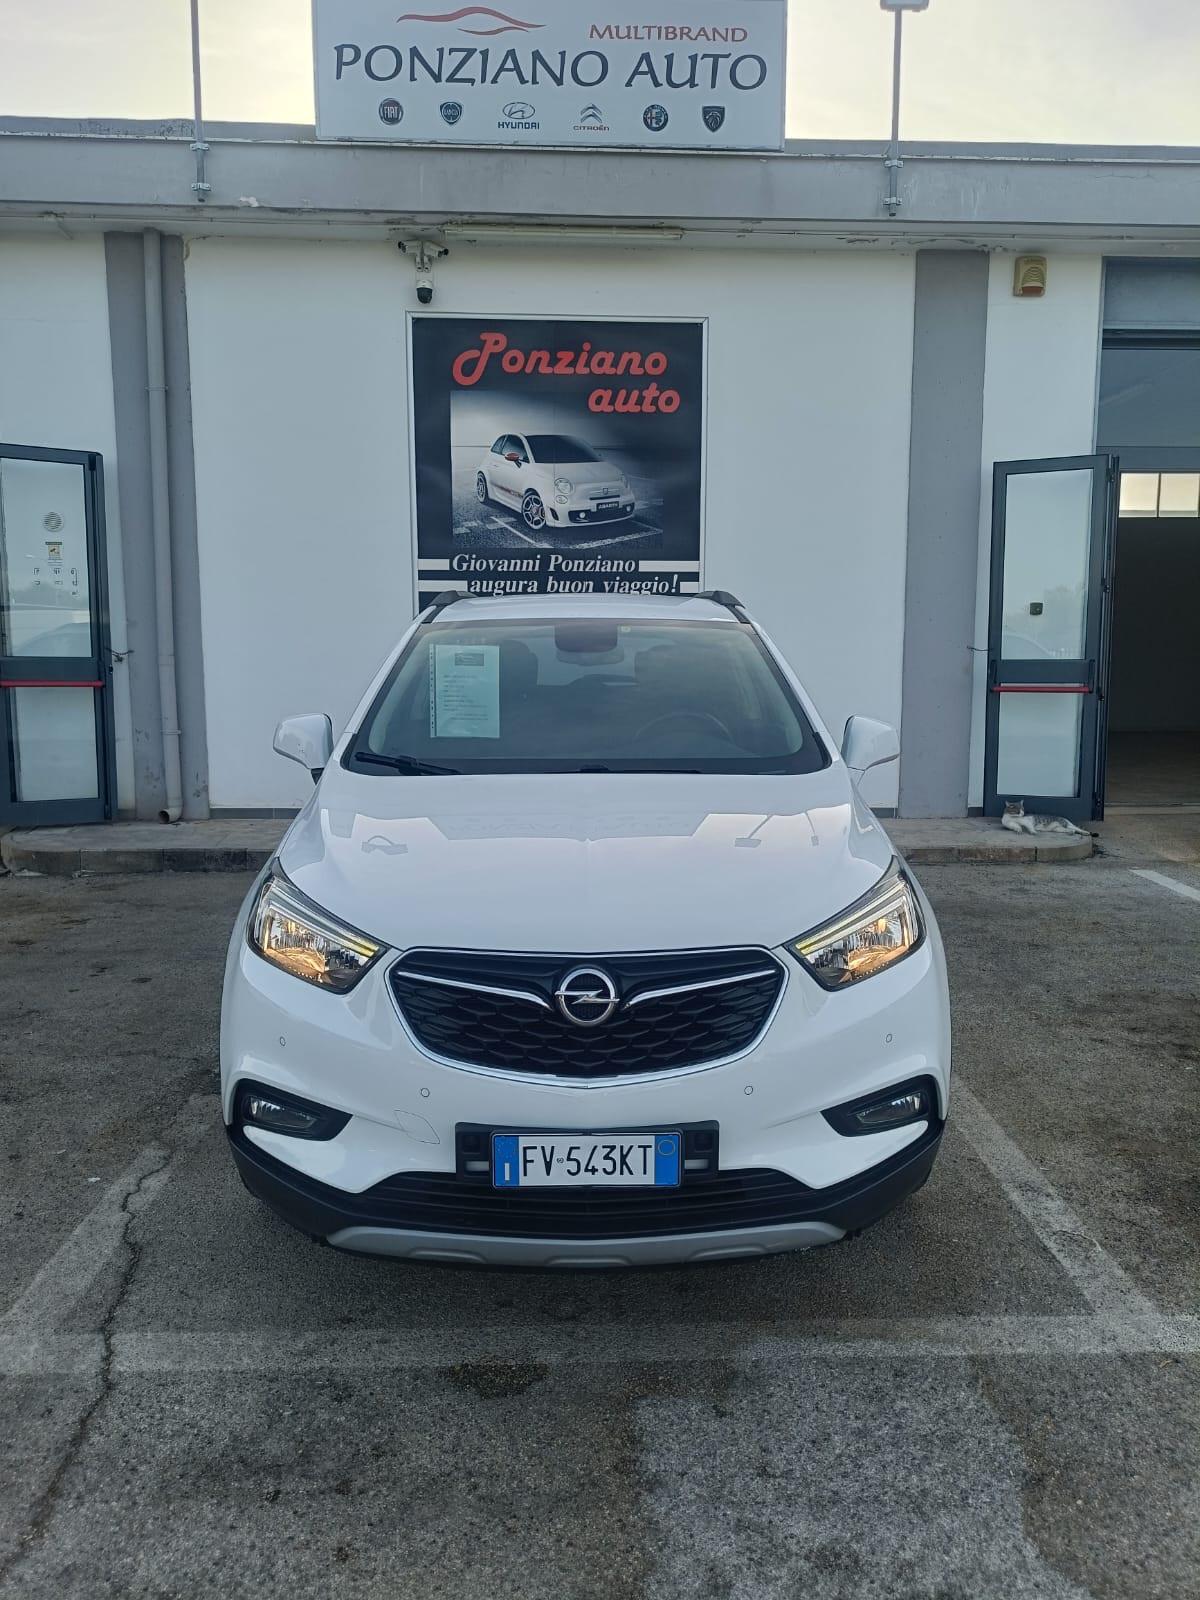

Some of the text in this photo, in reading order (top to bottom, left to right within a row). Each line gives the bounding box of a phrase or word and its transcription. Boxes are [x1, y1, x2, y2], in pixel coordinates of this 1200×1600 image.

[589, 24, 748, 42] MULTIBRAND
[334, 44, 767, 91] PONZIANO AUTO
[498, 122, 540, 130] HYUNDAI
[452, 332, 668, 386] Ponziano
[588, 383, 680, 413] auto
[452, 554, 636, 572] Giovanni Ponziano
[470, 574, 679, 596] augura buon viaggio!
